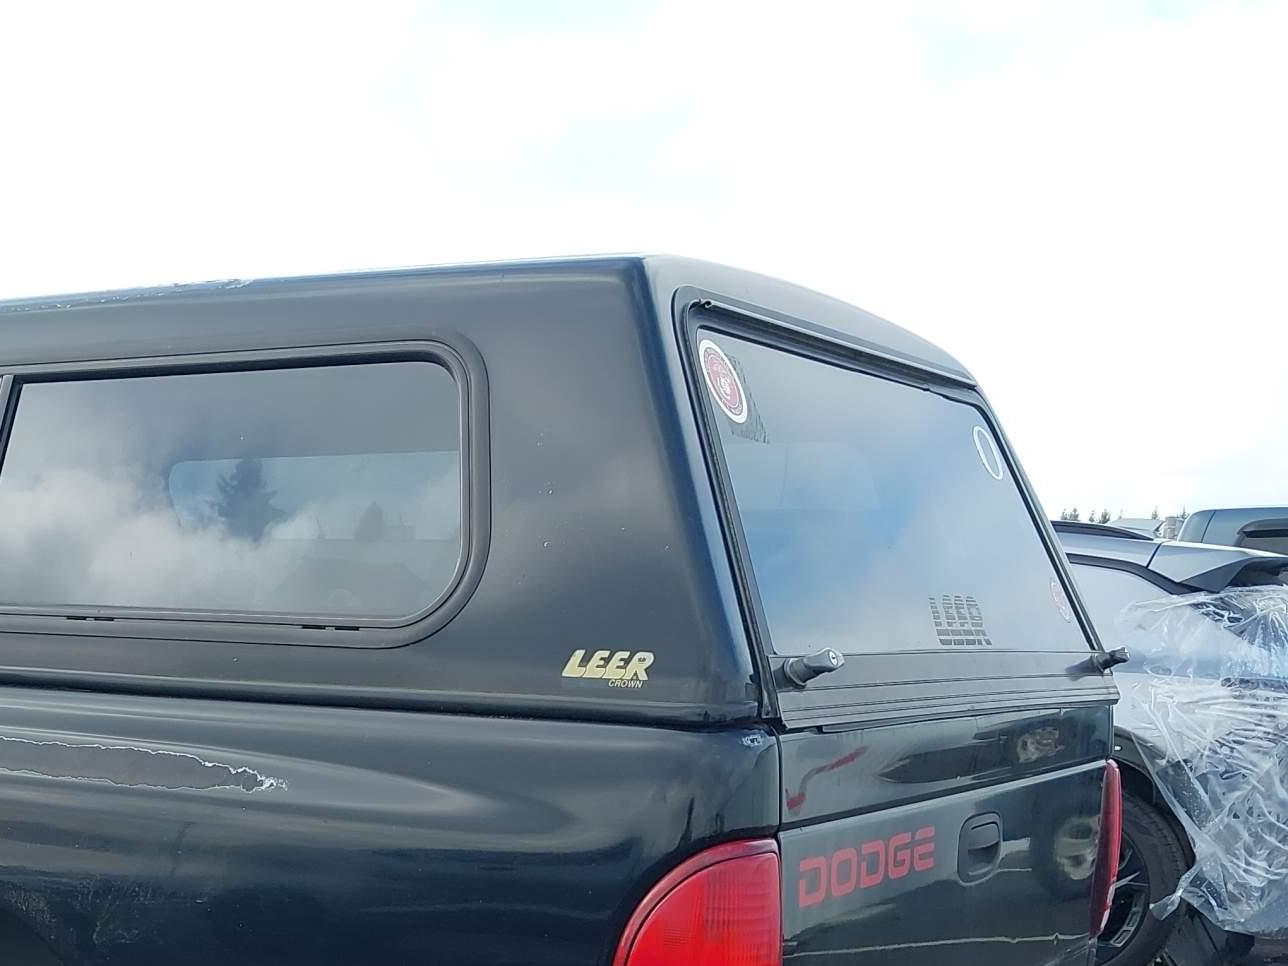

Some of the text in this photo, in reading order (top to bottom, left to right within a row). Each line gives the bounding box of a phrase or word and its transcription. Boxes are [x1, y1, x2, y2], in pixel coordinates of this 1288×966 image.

[562, 649, 654, 680] LEER
[608, 679, 643, 689] CROWN
[798, 826, 936, 909] DODGE
